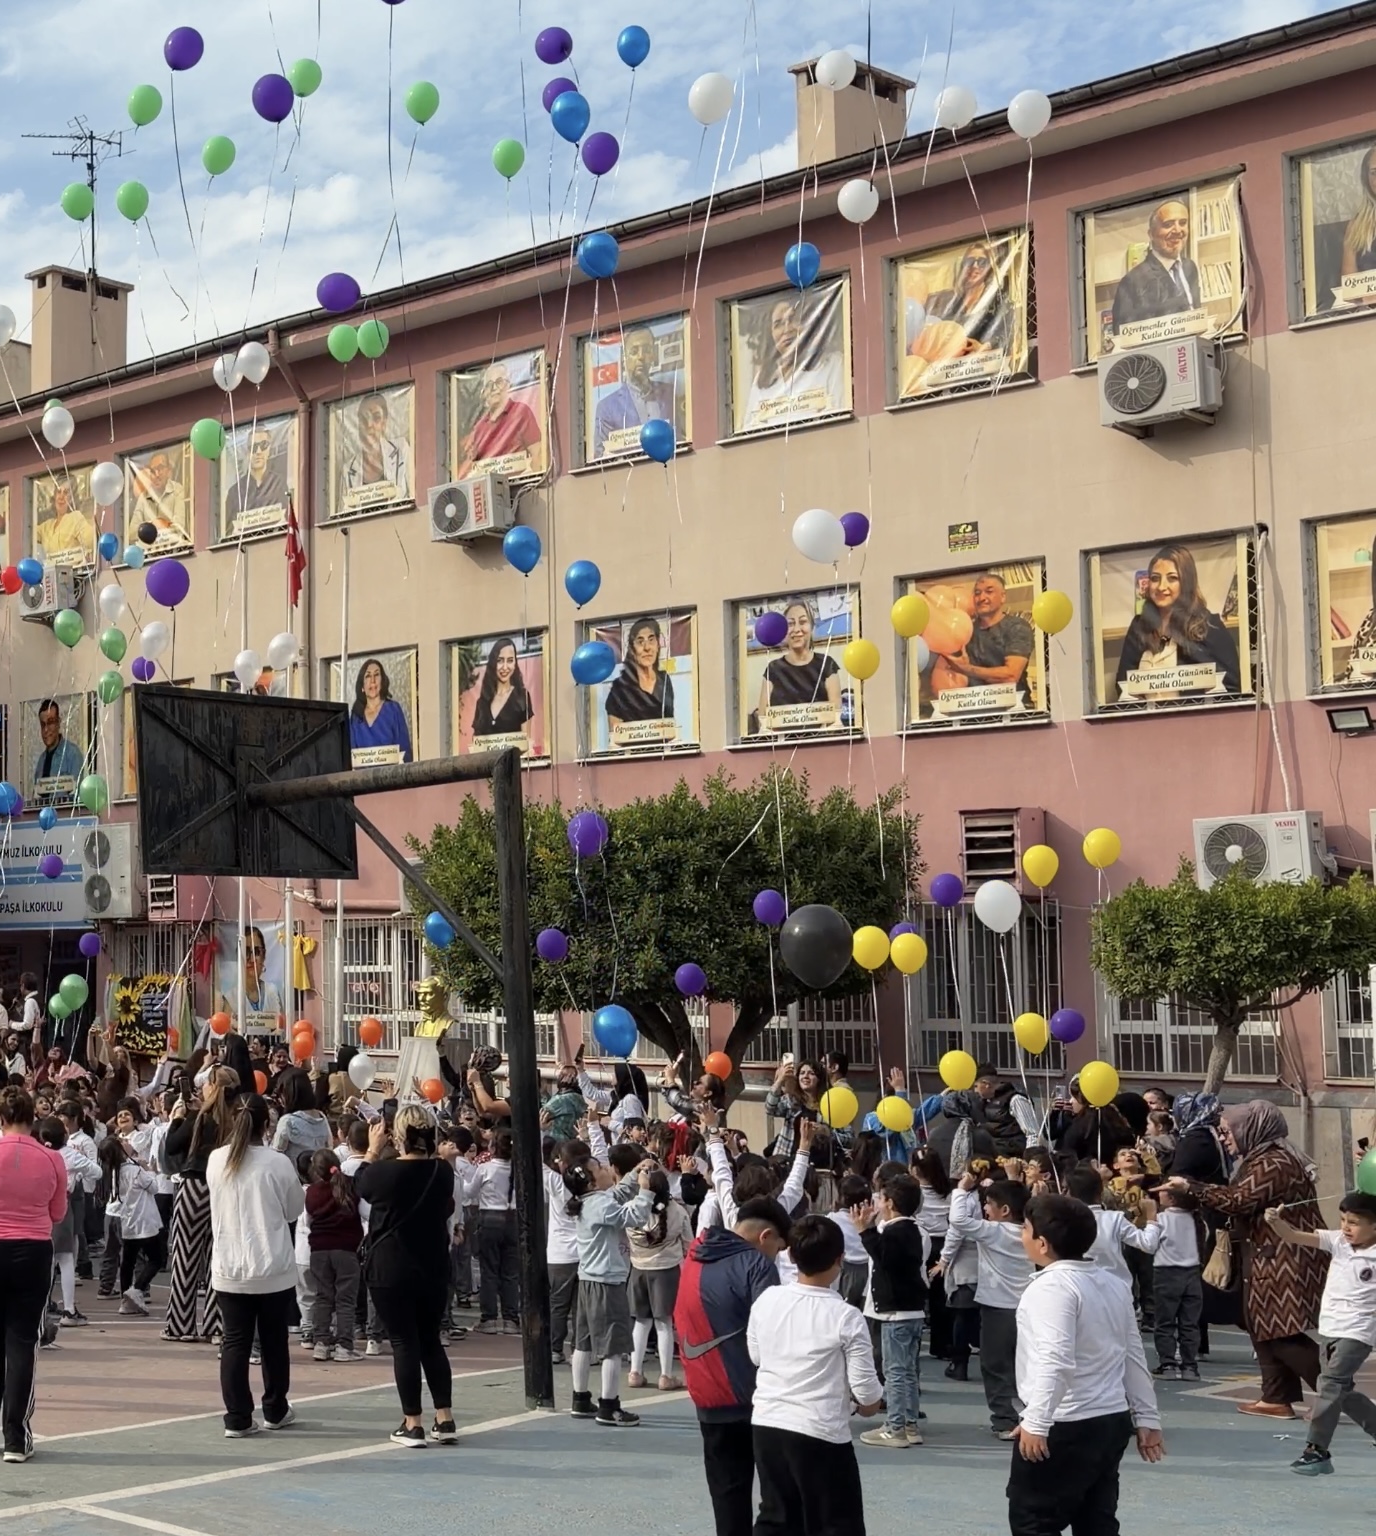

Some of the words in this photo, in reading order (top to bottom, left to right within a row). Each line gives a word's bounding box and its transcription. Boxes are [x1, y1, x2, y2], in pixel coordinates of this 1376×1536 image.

[1122, 319, 1168, 337] Öğretmenler
[1170, 312, 1205, 327] Gününüz
[1141, 330, 1163, 341] Kutlu
[1163, 326, 1186, 337] Olsun
[1177, 346, 1187, 374] ALTUS
[473, 483, 484, 523] VESTEL
[1129, 670, 1175, 684] Öğretmenler
[1178, 667, 1213, 678] Gününüz
[1149, 681, 1170, 690] Kutlu
[1171, 680, 1194, 688] Olsun
[940, 690, 981, 702] Öğretmenler
[983, 687, 1014, 697] Gününüz
[957, 700, 976, 708] Kutlu
[1274, 820, 1297, 828] VESTEL
[21, 845, 62, 859] İLKOKULU
[0, 902, 21, 915] PAŞA
[21, 900, 63, 913] İLKOKULU
